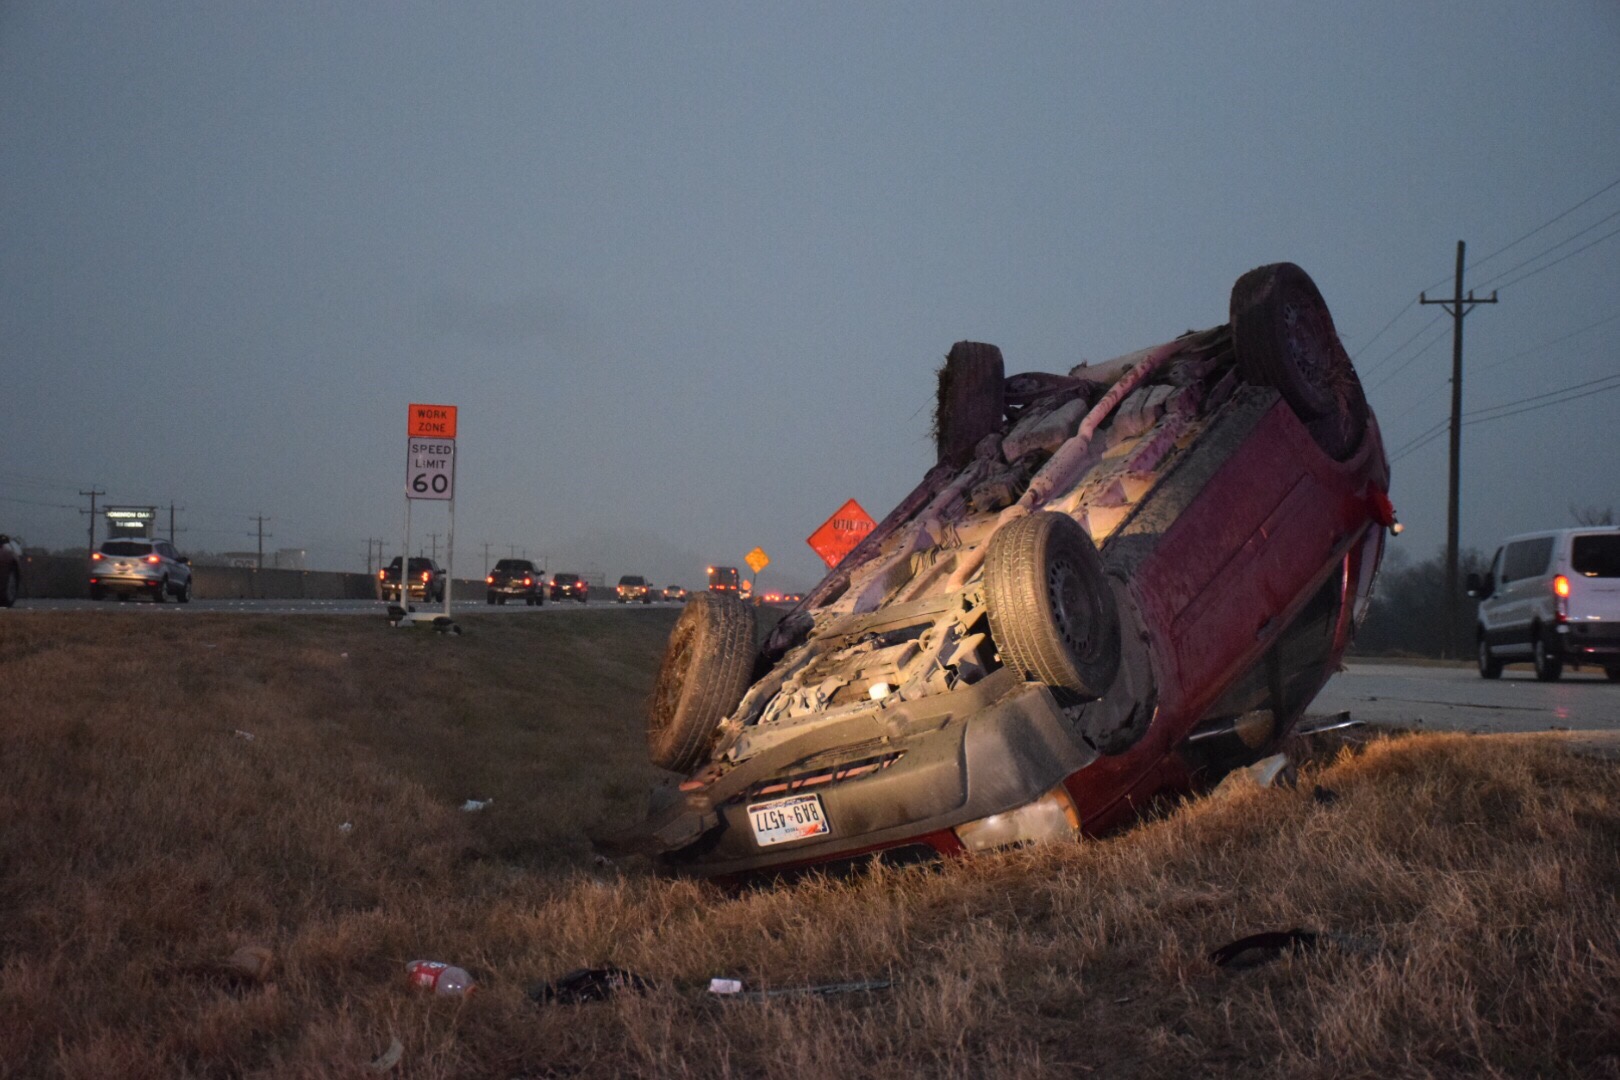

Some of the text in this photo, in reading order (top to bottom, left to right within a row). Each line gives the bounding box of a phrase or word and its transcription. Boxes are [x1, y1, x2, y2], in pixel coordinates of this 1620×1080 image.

[417, 409, 447, 419] WORK
[418, 422, 446, 432] ZONE
[412, 444, 452, 455] SPEED
[415, 458, 447, 469] LIMIT
[412, 473, 448, 493] 60
[833, 519, 871, 531] UTILITY
[793, 802, 819, 824] BA9
[756, 809, 786, 832] 4577
